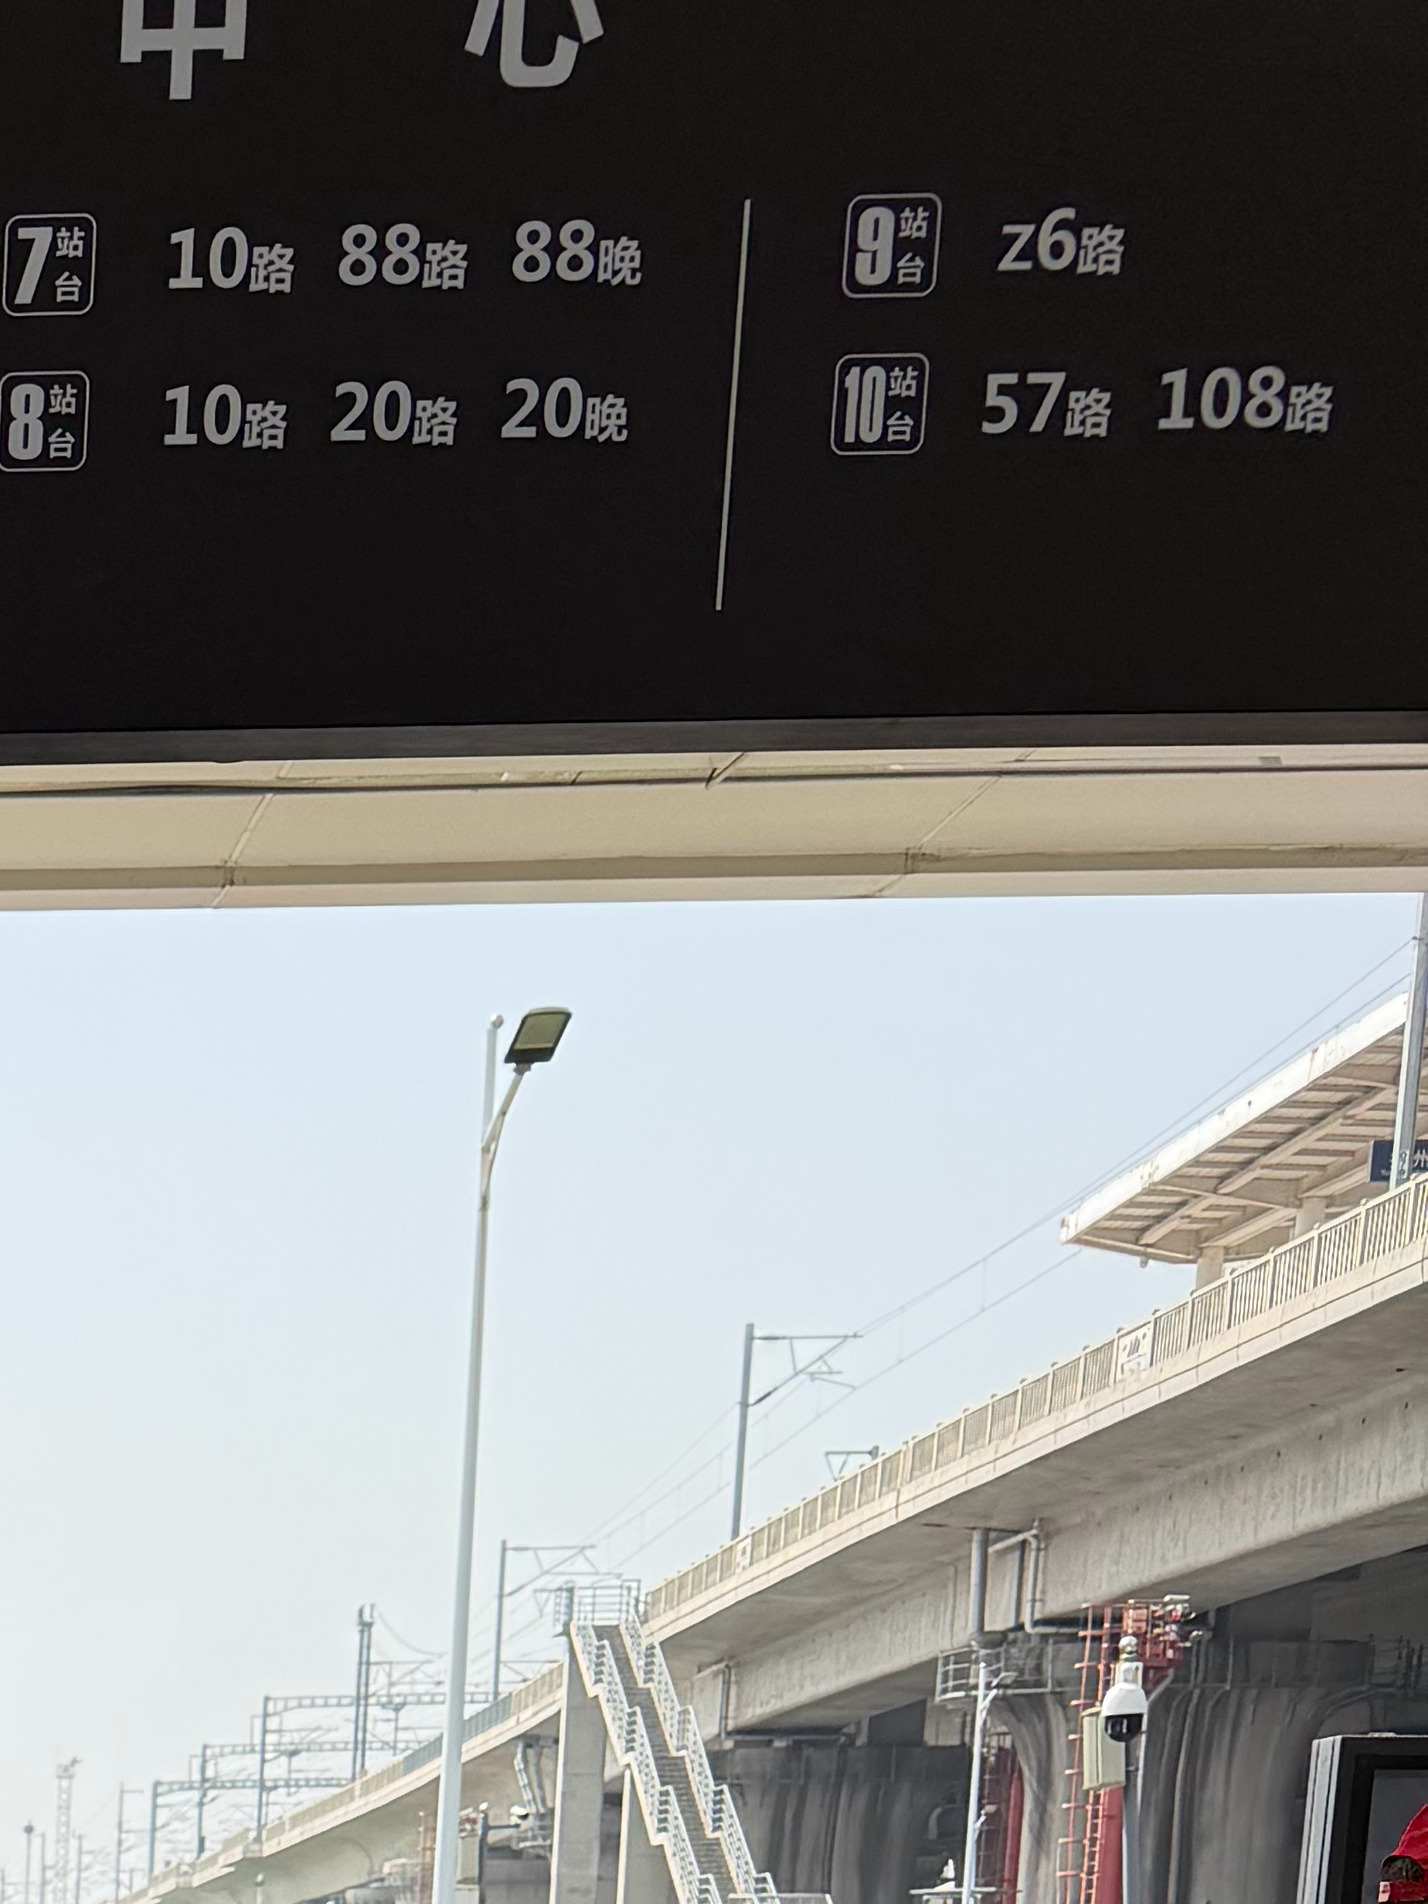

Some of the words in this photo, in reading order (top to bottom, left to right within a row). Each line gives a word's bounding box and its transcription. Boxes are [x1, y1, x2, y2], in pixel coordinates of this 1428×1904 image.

[168, 227, 294, 294] 10路
[340, 223, 469, 290] 88路
[511, 219, 643, 287] 88晚
[164, 384, 288, 450] 10路
[330, 380, 458, 447] 20路
[500, 377, 628, 444] 20晚
[981, 371, 1111, 438] 57路
[1157, 365, 1333, 435] 108路
